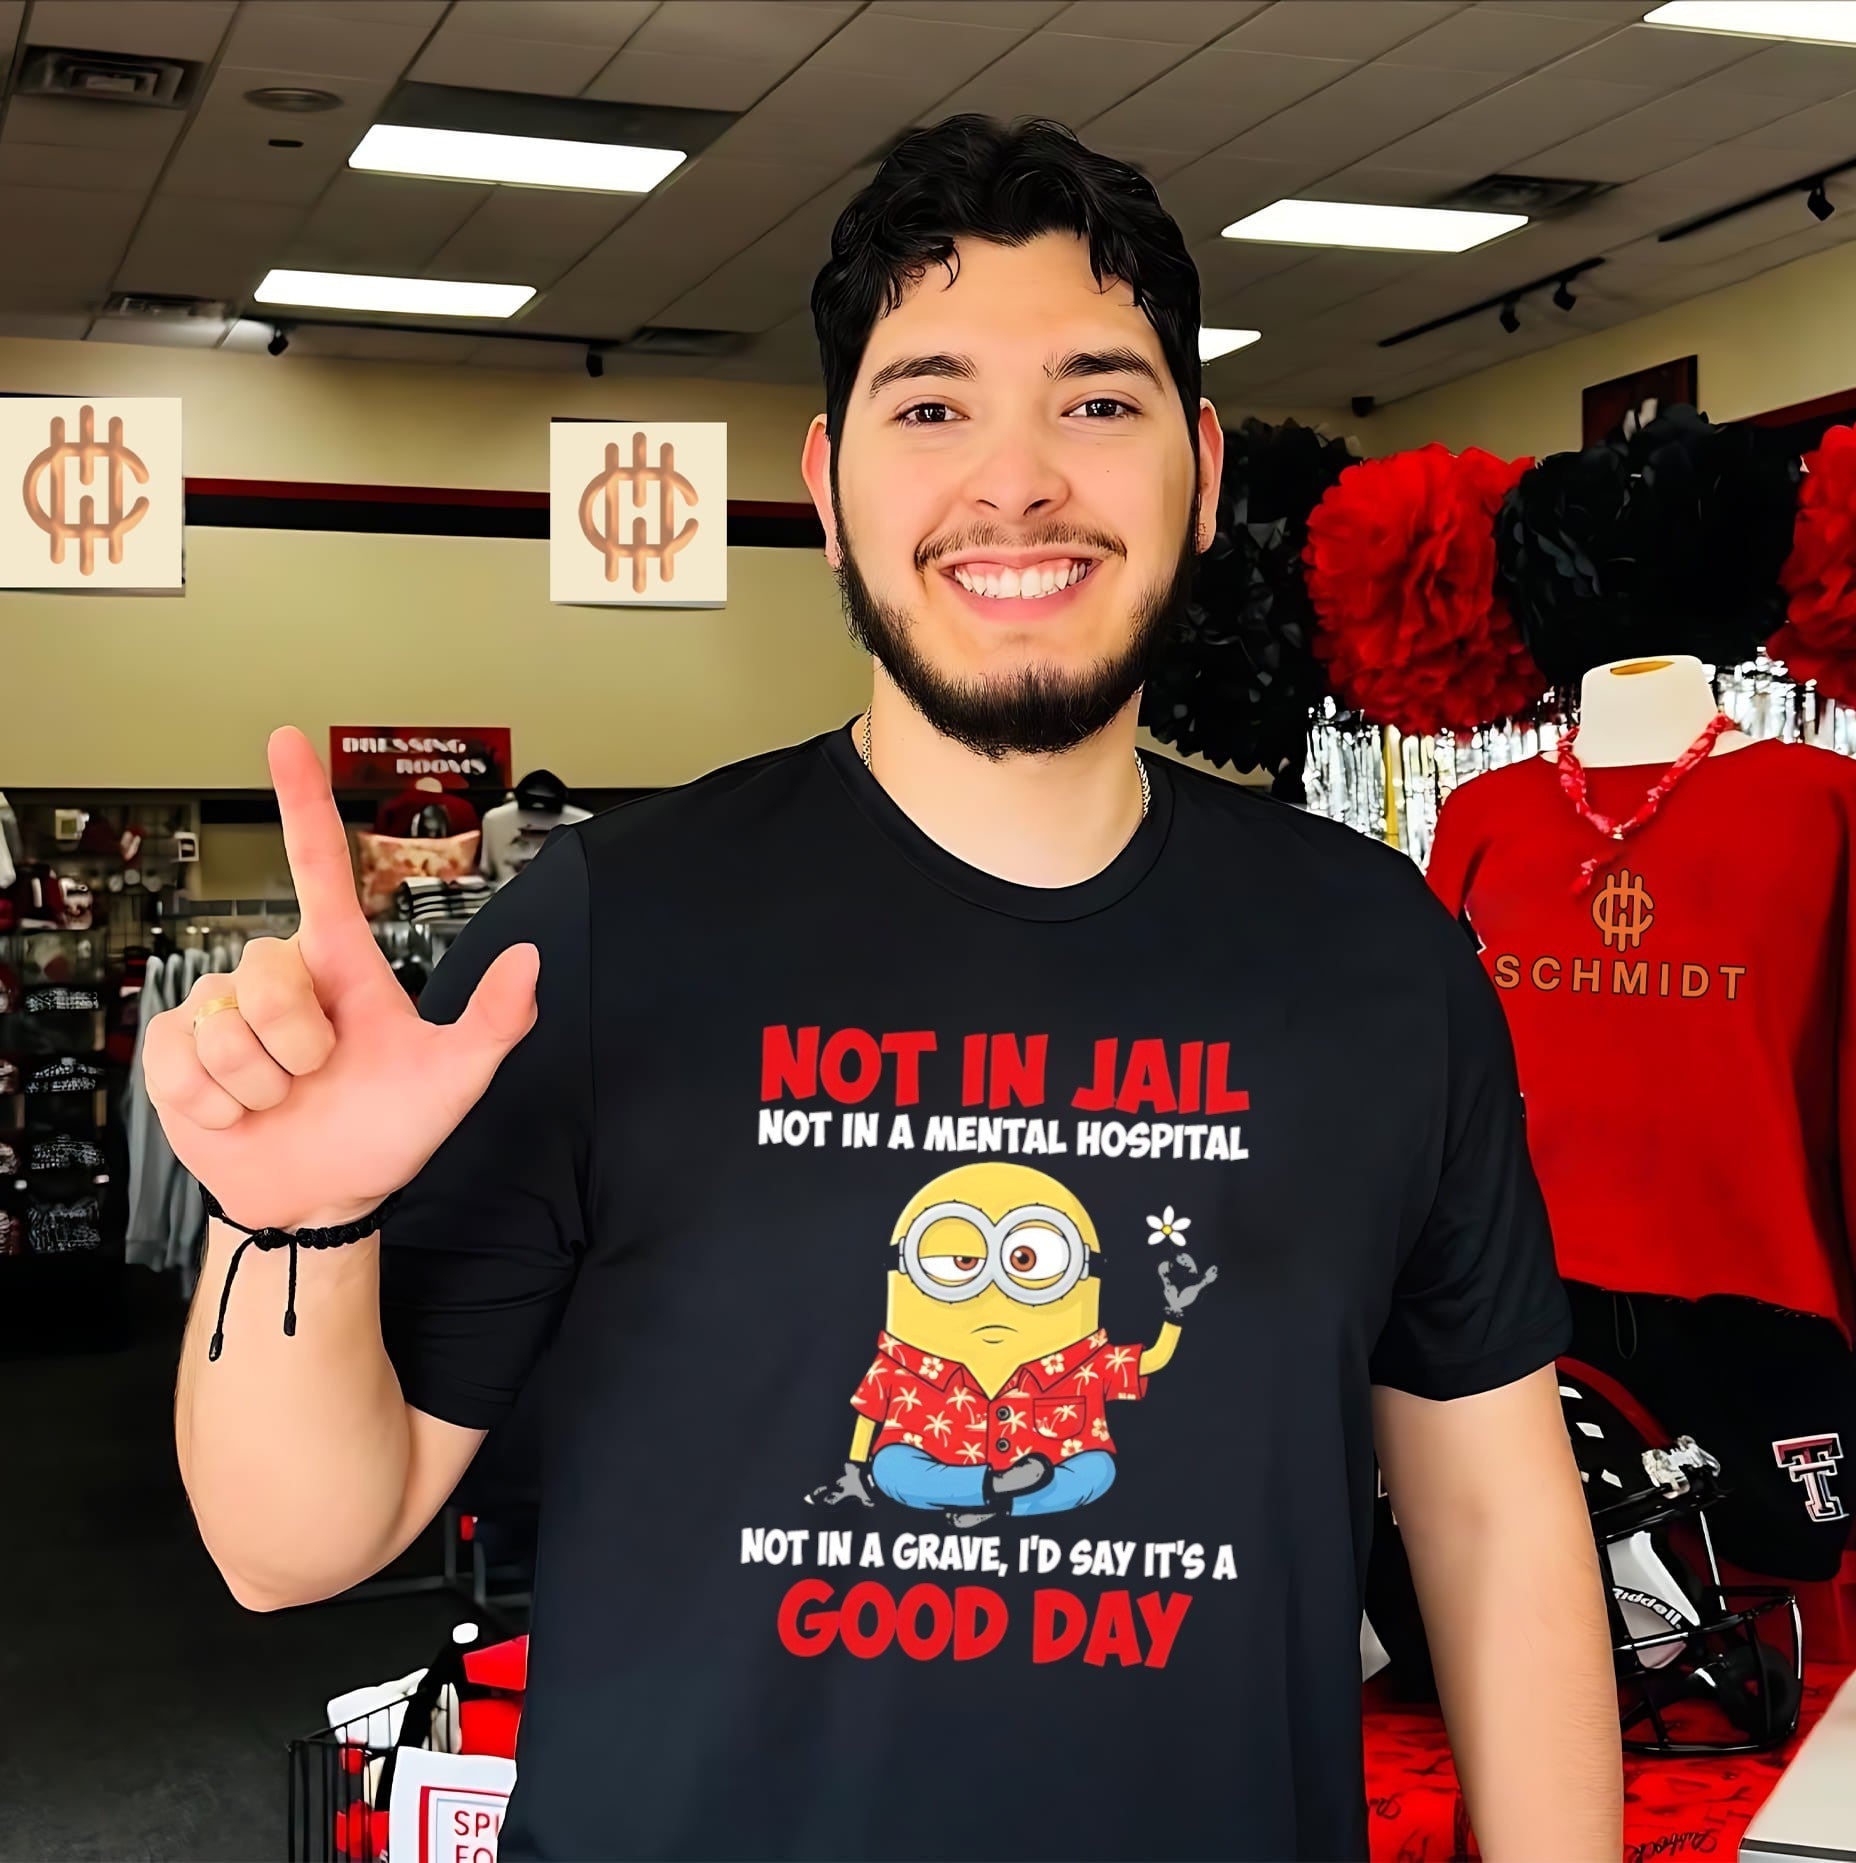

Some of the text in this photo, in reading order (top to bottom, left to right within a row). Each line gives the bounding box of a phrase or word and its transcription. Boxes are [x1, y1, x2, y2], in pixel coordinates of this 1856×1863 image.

[1494, 954, 1746, 1000] SCHMIDT
[760, 1025, 1250, 1116] NOT IN JAIL
[758, 1109, 1249, 1161] NOT IN A MENTAL HOSPITAL
[740, 1528, 1238, 1580] NOT IN A GRAVE, I'D SAY IT'S A
[777, 1579, 1193, 1669] GOOD DAY
